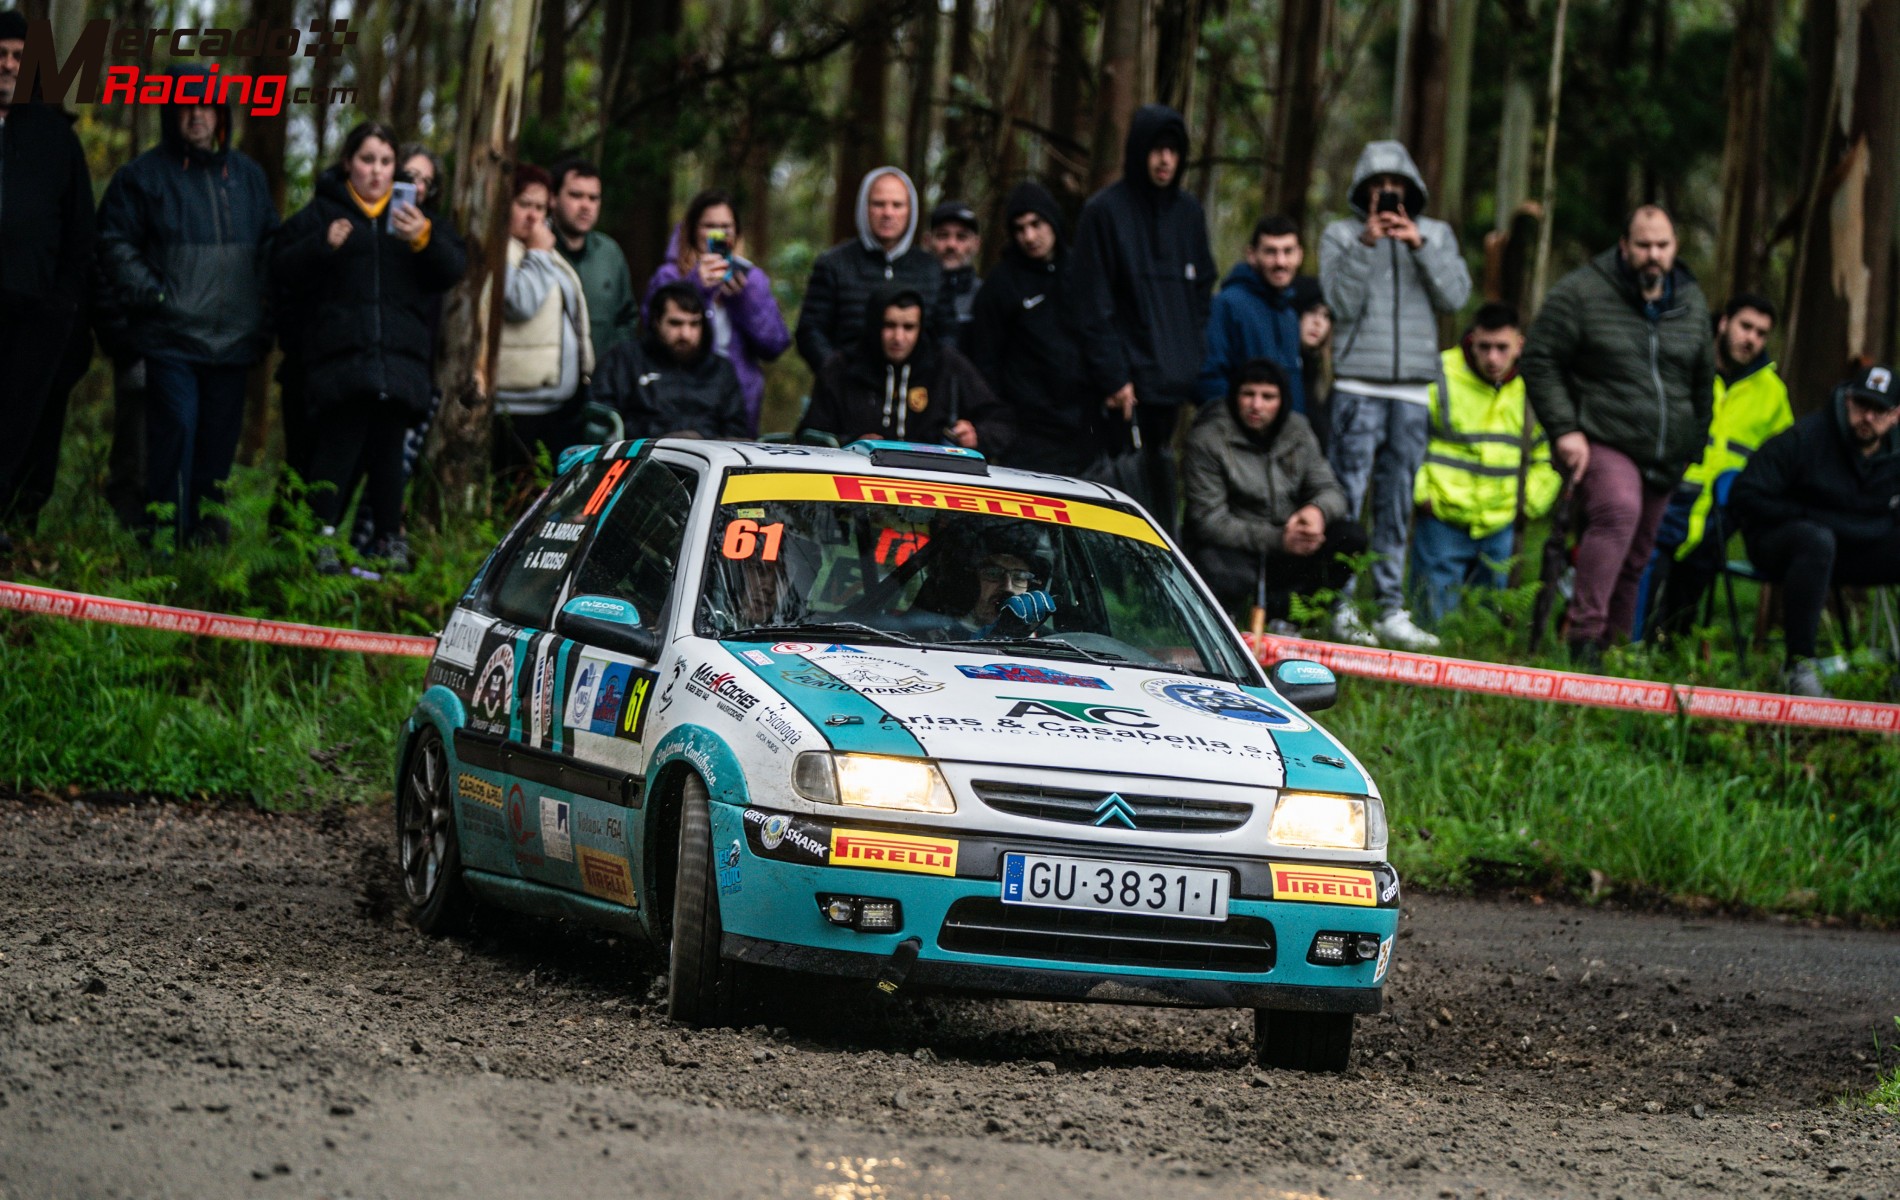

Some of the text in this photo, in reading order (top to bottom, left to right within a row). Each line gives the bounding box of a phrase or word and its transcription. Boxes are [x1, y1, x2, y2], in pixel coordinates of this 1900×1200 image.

[583, 459, 631, 516] 61
[832, 475, 1072, 524] PIRELLI
[722, 518, 784, 562] 61
[541, 551, 568, 571] VIZOSO
[793, 675, 933, 695] PUNTO APARTE
[623, 676, 651, 733] 61
[879, 714, 983, 727] Arias
[997, 717, 1027, 729] &
[1038, 721, 1231, 749] Casabella
[881, 725, 1123, 743] CONSTRUCCIONES
[743, 809, 768, 825] GREY
[785, 828, 828, 858] SHARK
[834, 836, 954, 868] PIRELLI
[583, 854, 628, 896] PIRELLI
[1008, 883, 1019, 895] E
[1276, 870, 1373, 900] PIRELLI
